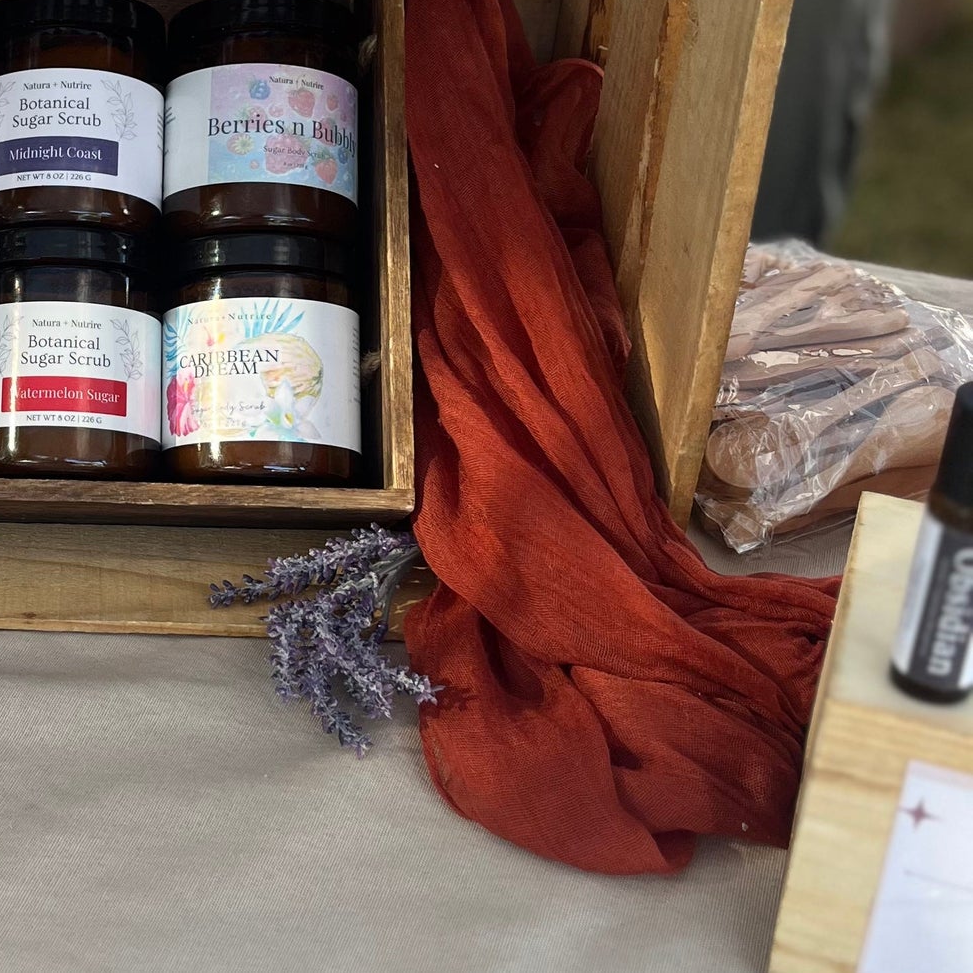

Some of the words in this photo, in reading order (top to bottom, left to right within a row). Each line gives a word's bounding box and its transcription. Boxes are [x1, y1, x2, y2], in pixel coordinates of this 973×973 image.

[23, 81, 51, 91] Natura
[60, 80, 92, 90] Nutrire
[269, 76, 294, 85] Natura
[301, 79, 324, 90] Nutrire
[19, 96, 90, 111] Botanical
[12, 114, 53, 129] Sugar
[58, 112, 101, 127] Scrub
[208, 114, 285, 137] Berries
[293, 122, 304, 136] n
[9, 146, 64, 161] Midnight
[66, 146, 103, 161] Coast
[33, 319, 61, 328] Natura
[71, 319, 102, 329] Nutrire
[28, 334, 100, 350] Botanical
[20, 351, 64, 368] Sugar
[69, 352, 111, 368] Scrub
[179, 349, 280, 369] CARIBBEAN
[194, 362, 259, 378] DREAM
[87, 388, 120, 404] Sugar
[26, 414, 41, 422] NET
